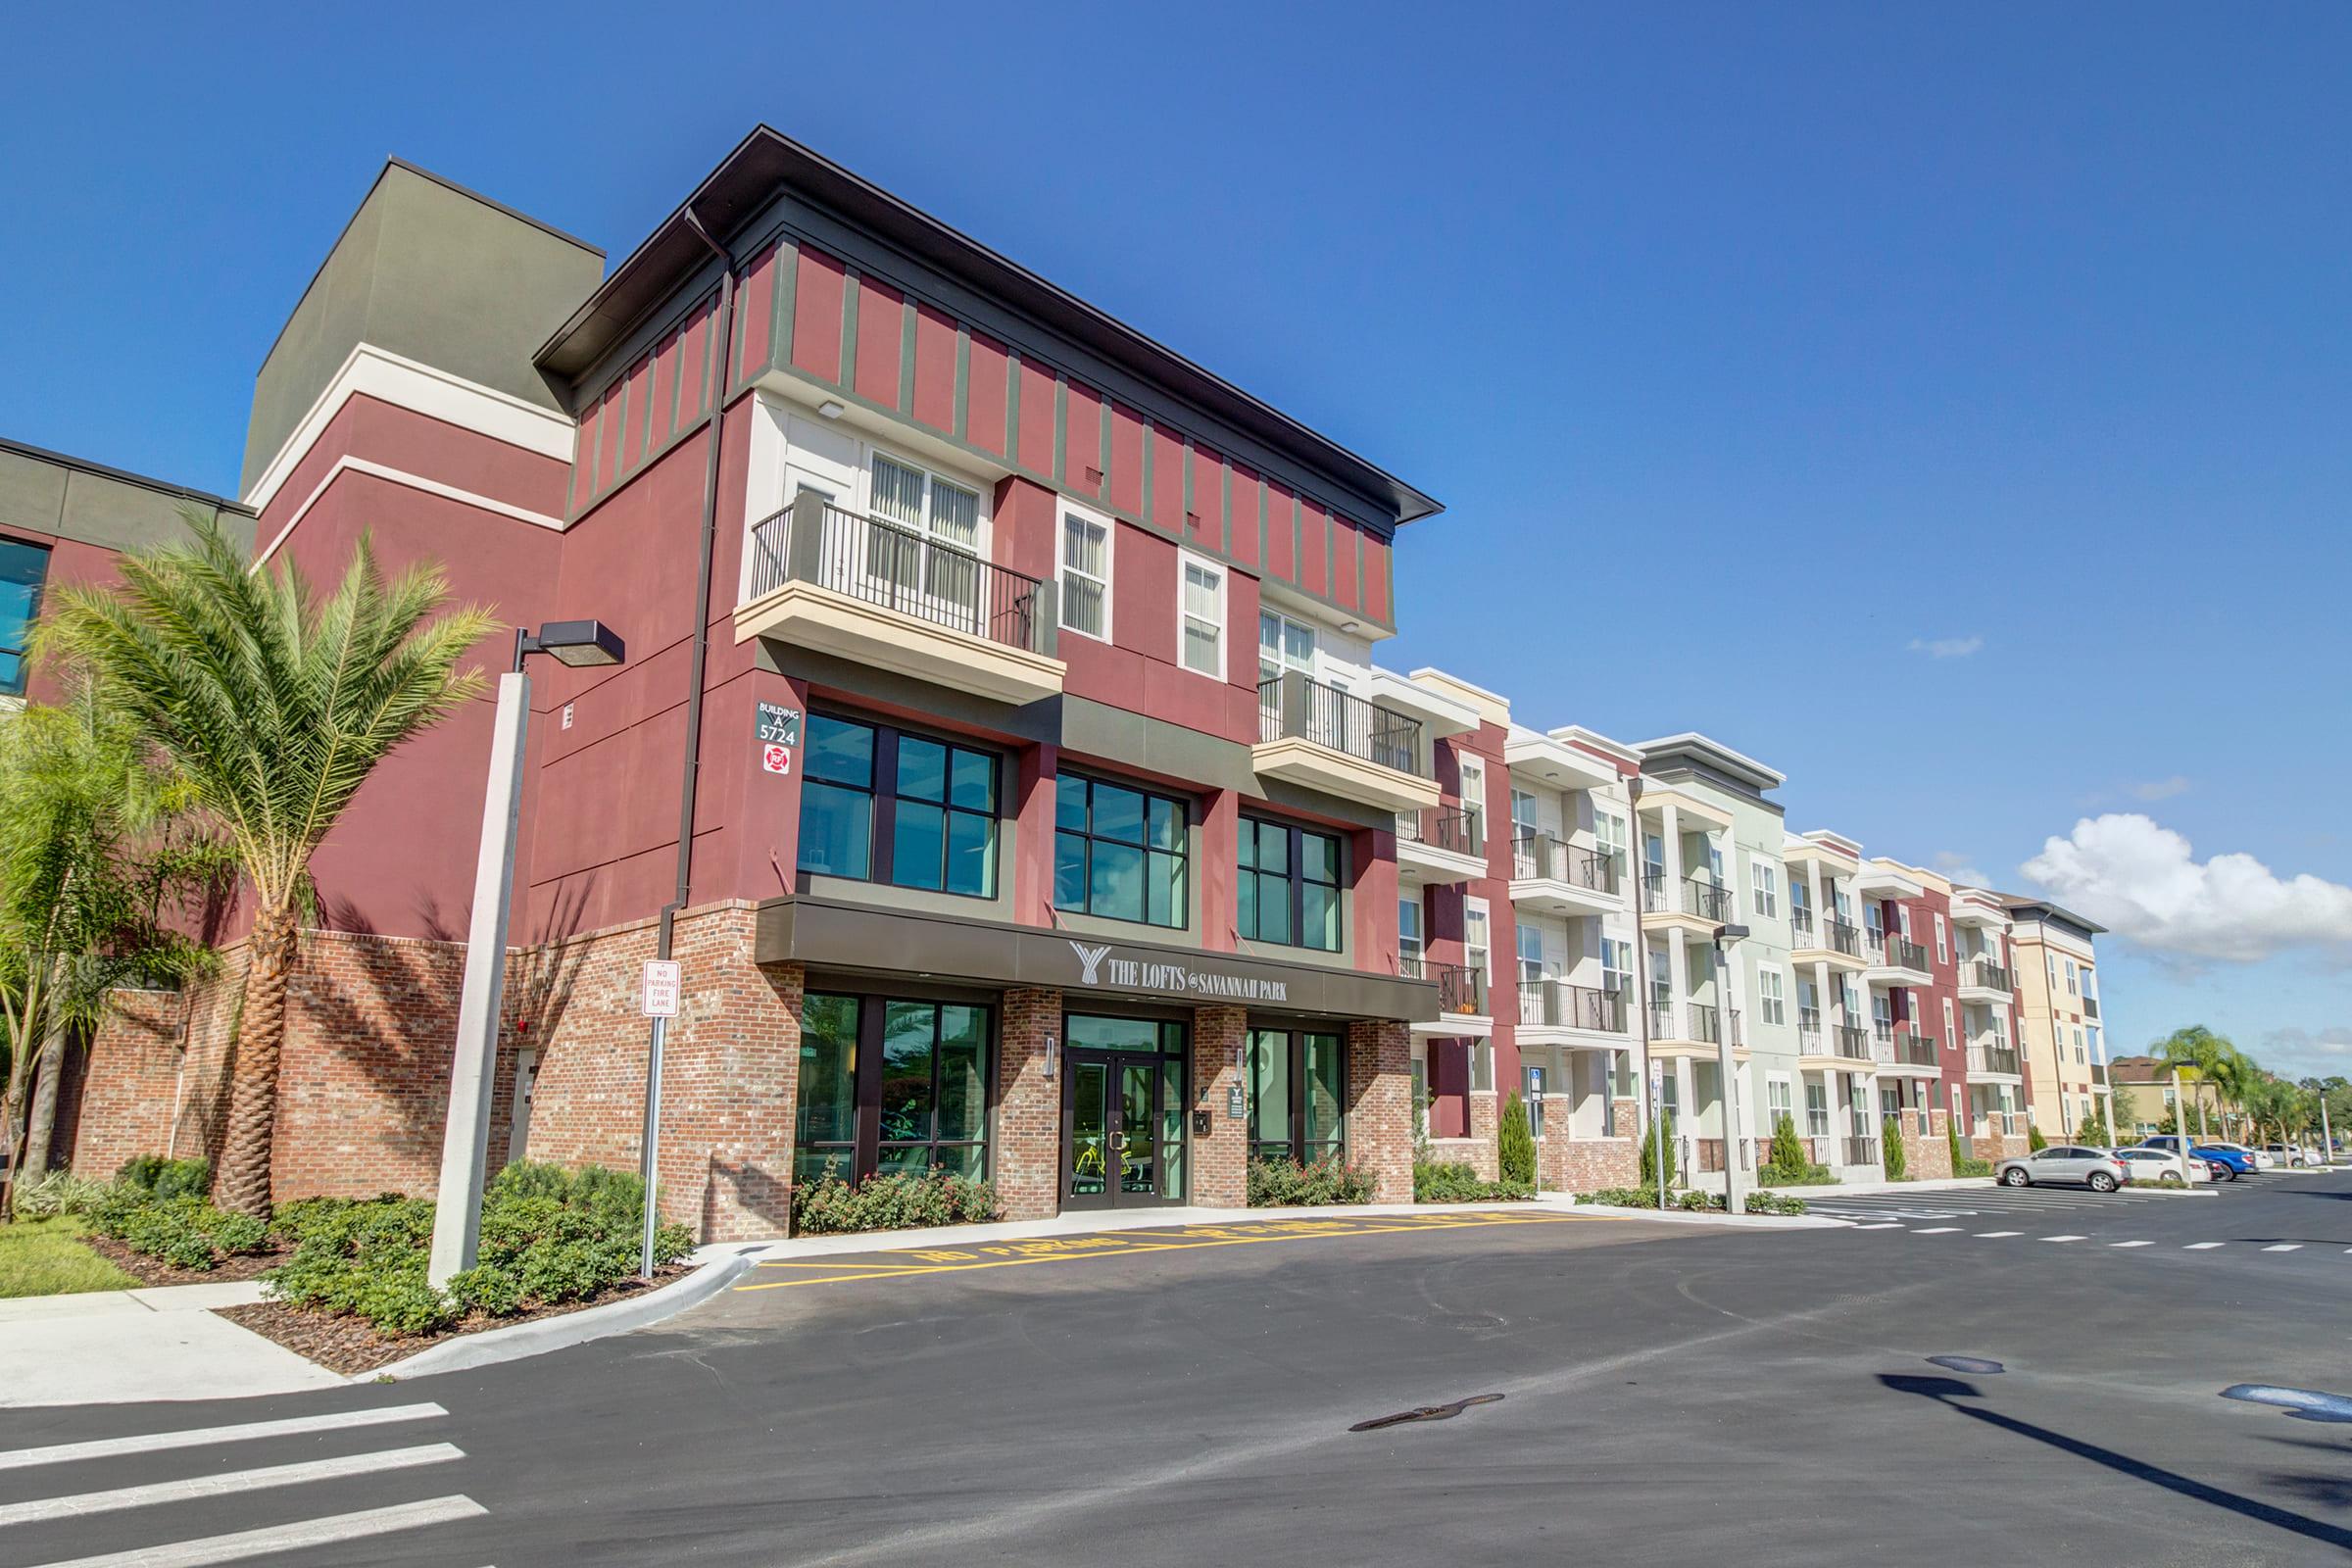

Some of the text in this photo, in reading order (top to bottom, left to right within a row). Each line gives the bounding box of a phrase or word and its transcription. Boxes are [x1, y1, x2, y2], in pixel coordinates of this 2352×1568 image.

[760, 703, 800, 719] BUILDING
[774, 716, 783, 727] A
[760, 724, 795, 746] 5724
[647, 979, 676, 988] PARKING
[1108, 958, 1138, 986] THE
[1142, 962, 1186, 992] LOFTS
[1259, 980, 1288, 1002] PARK
[912, 1250, 979, 1263] NO
